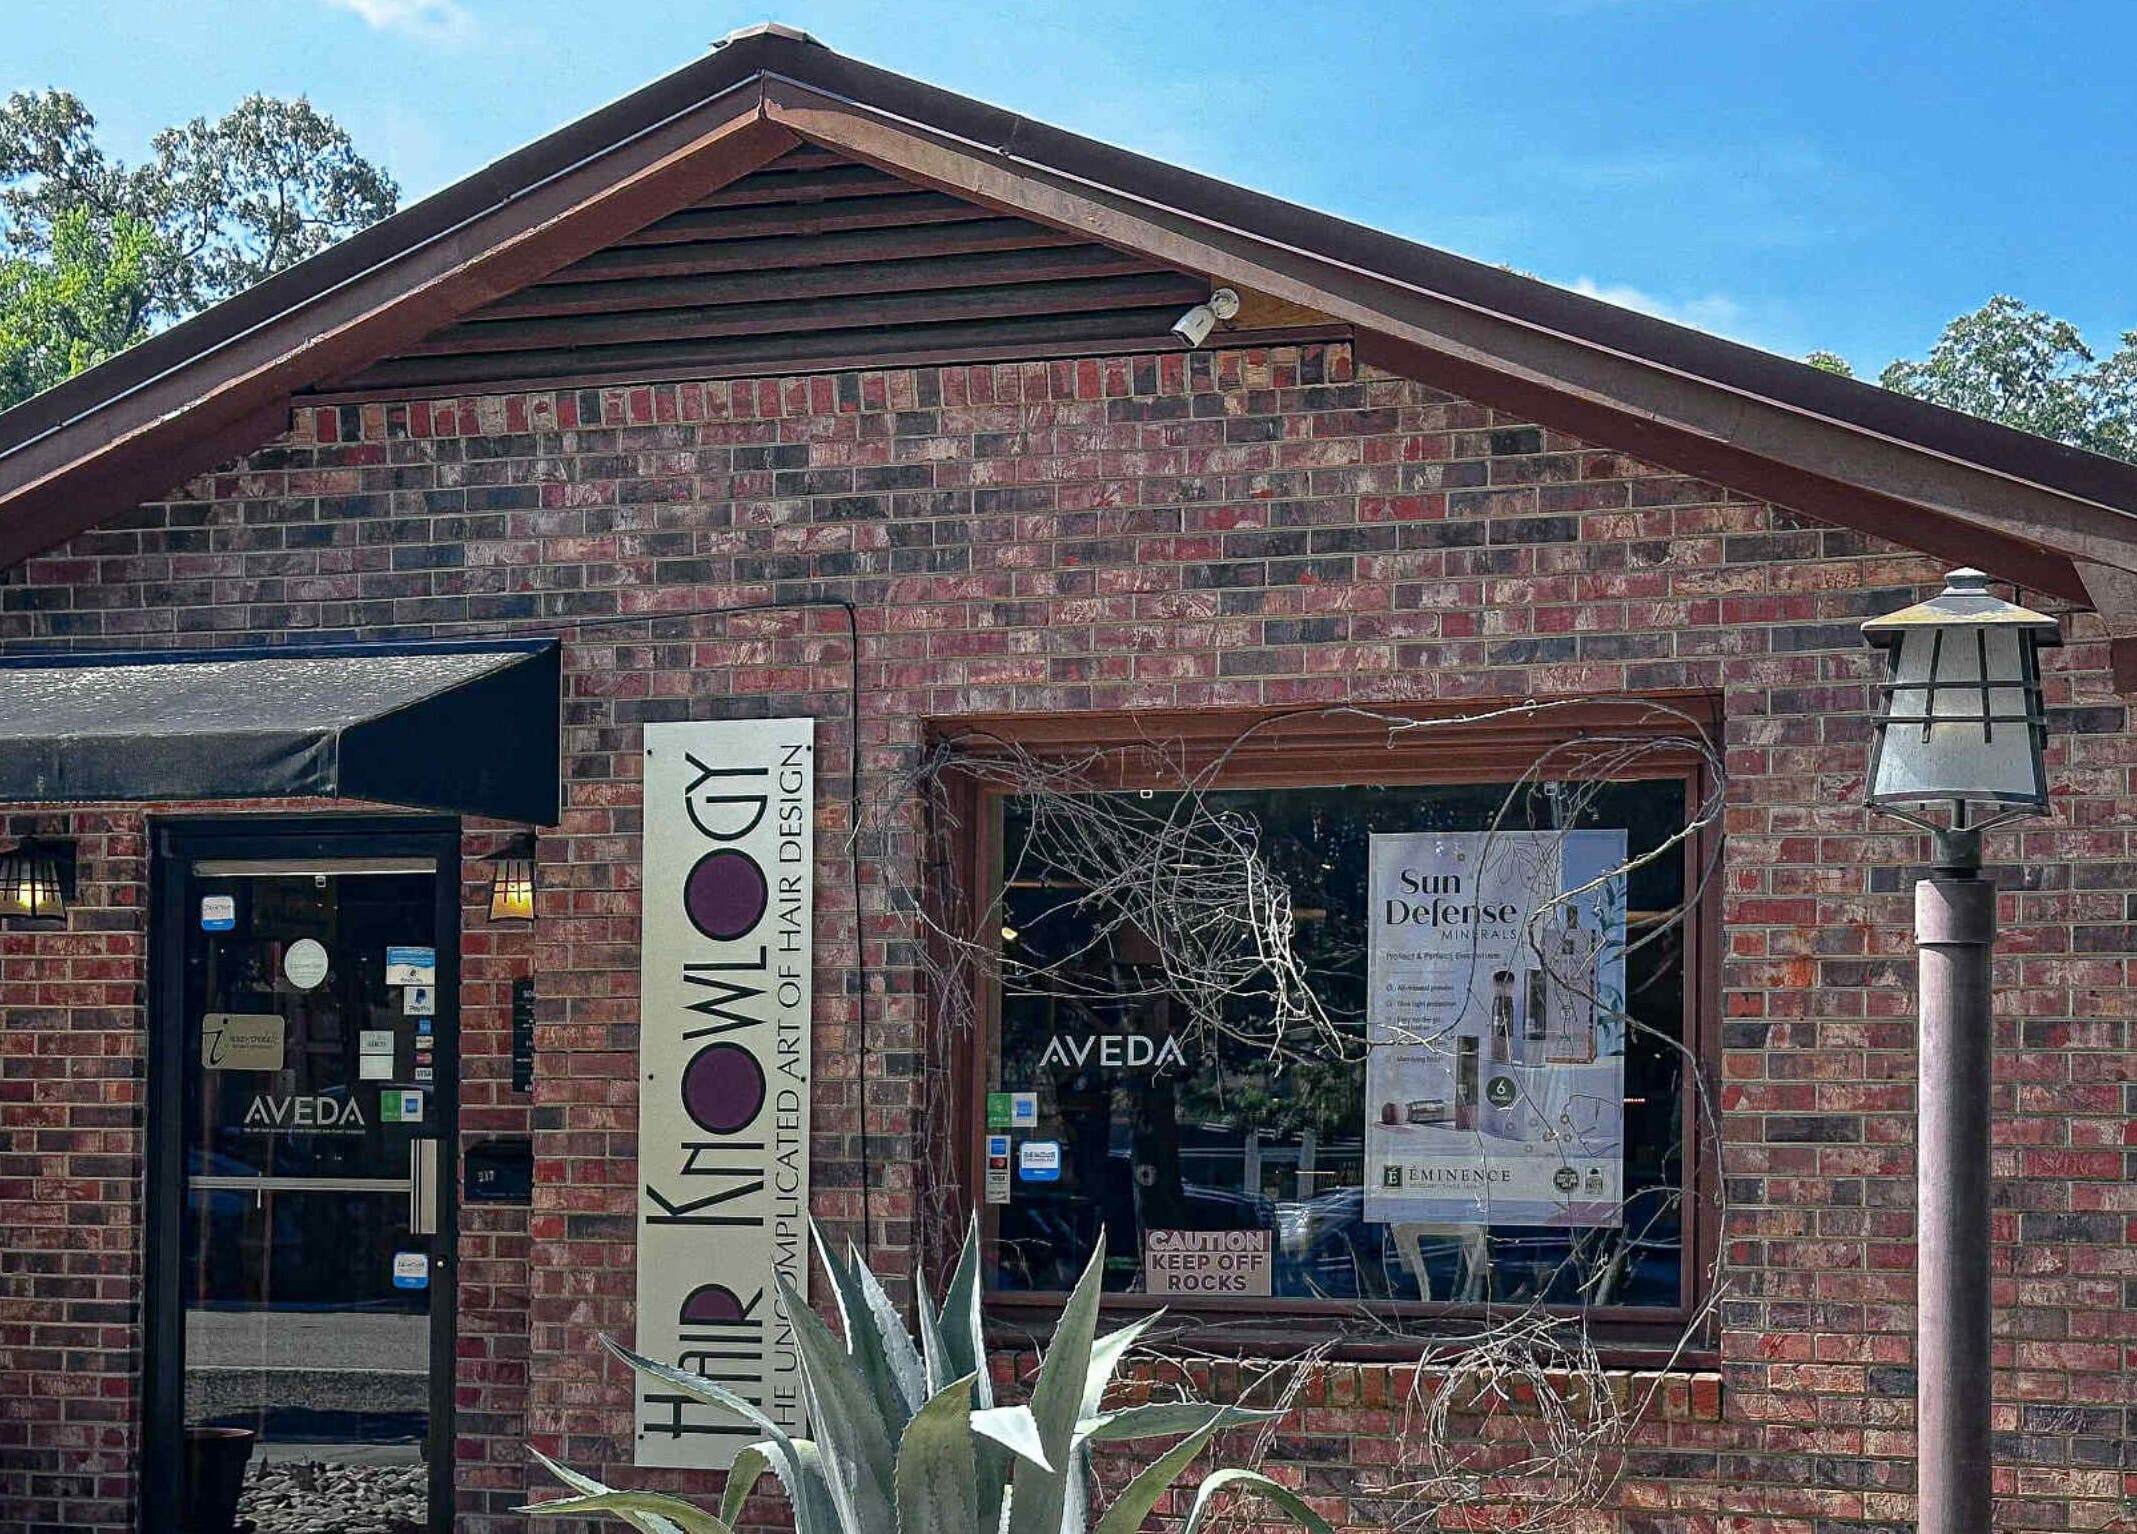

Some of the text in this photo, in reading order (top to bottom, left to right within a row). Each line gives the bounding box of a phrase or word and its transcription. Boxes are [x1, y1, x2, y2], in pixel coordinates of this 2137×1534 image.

[779, 745, 804, 863] DESIGN
[1400, 869, 1461, 895] Sun
[778, 875, 803, 951] HAIR
[1386, 898, 1518, 927] Defense
[778, 965, 802, 1008] OF
[777, 1019, 801, 1081] ART
[1039, 1034, 1187, 1068] AVEDA
[1496, 1079, 1506, 1095] 6
[243, 1095, 366, 1126] AVEDA
[1150, 1230, 1265, 1251] CAUTION
[1152, 1254, 1264, 1271] KEEP OFF
[1167, 1274, 1248, 1292] ROCKS
[773, 1386, 797, 1438] HE
